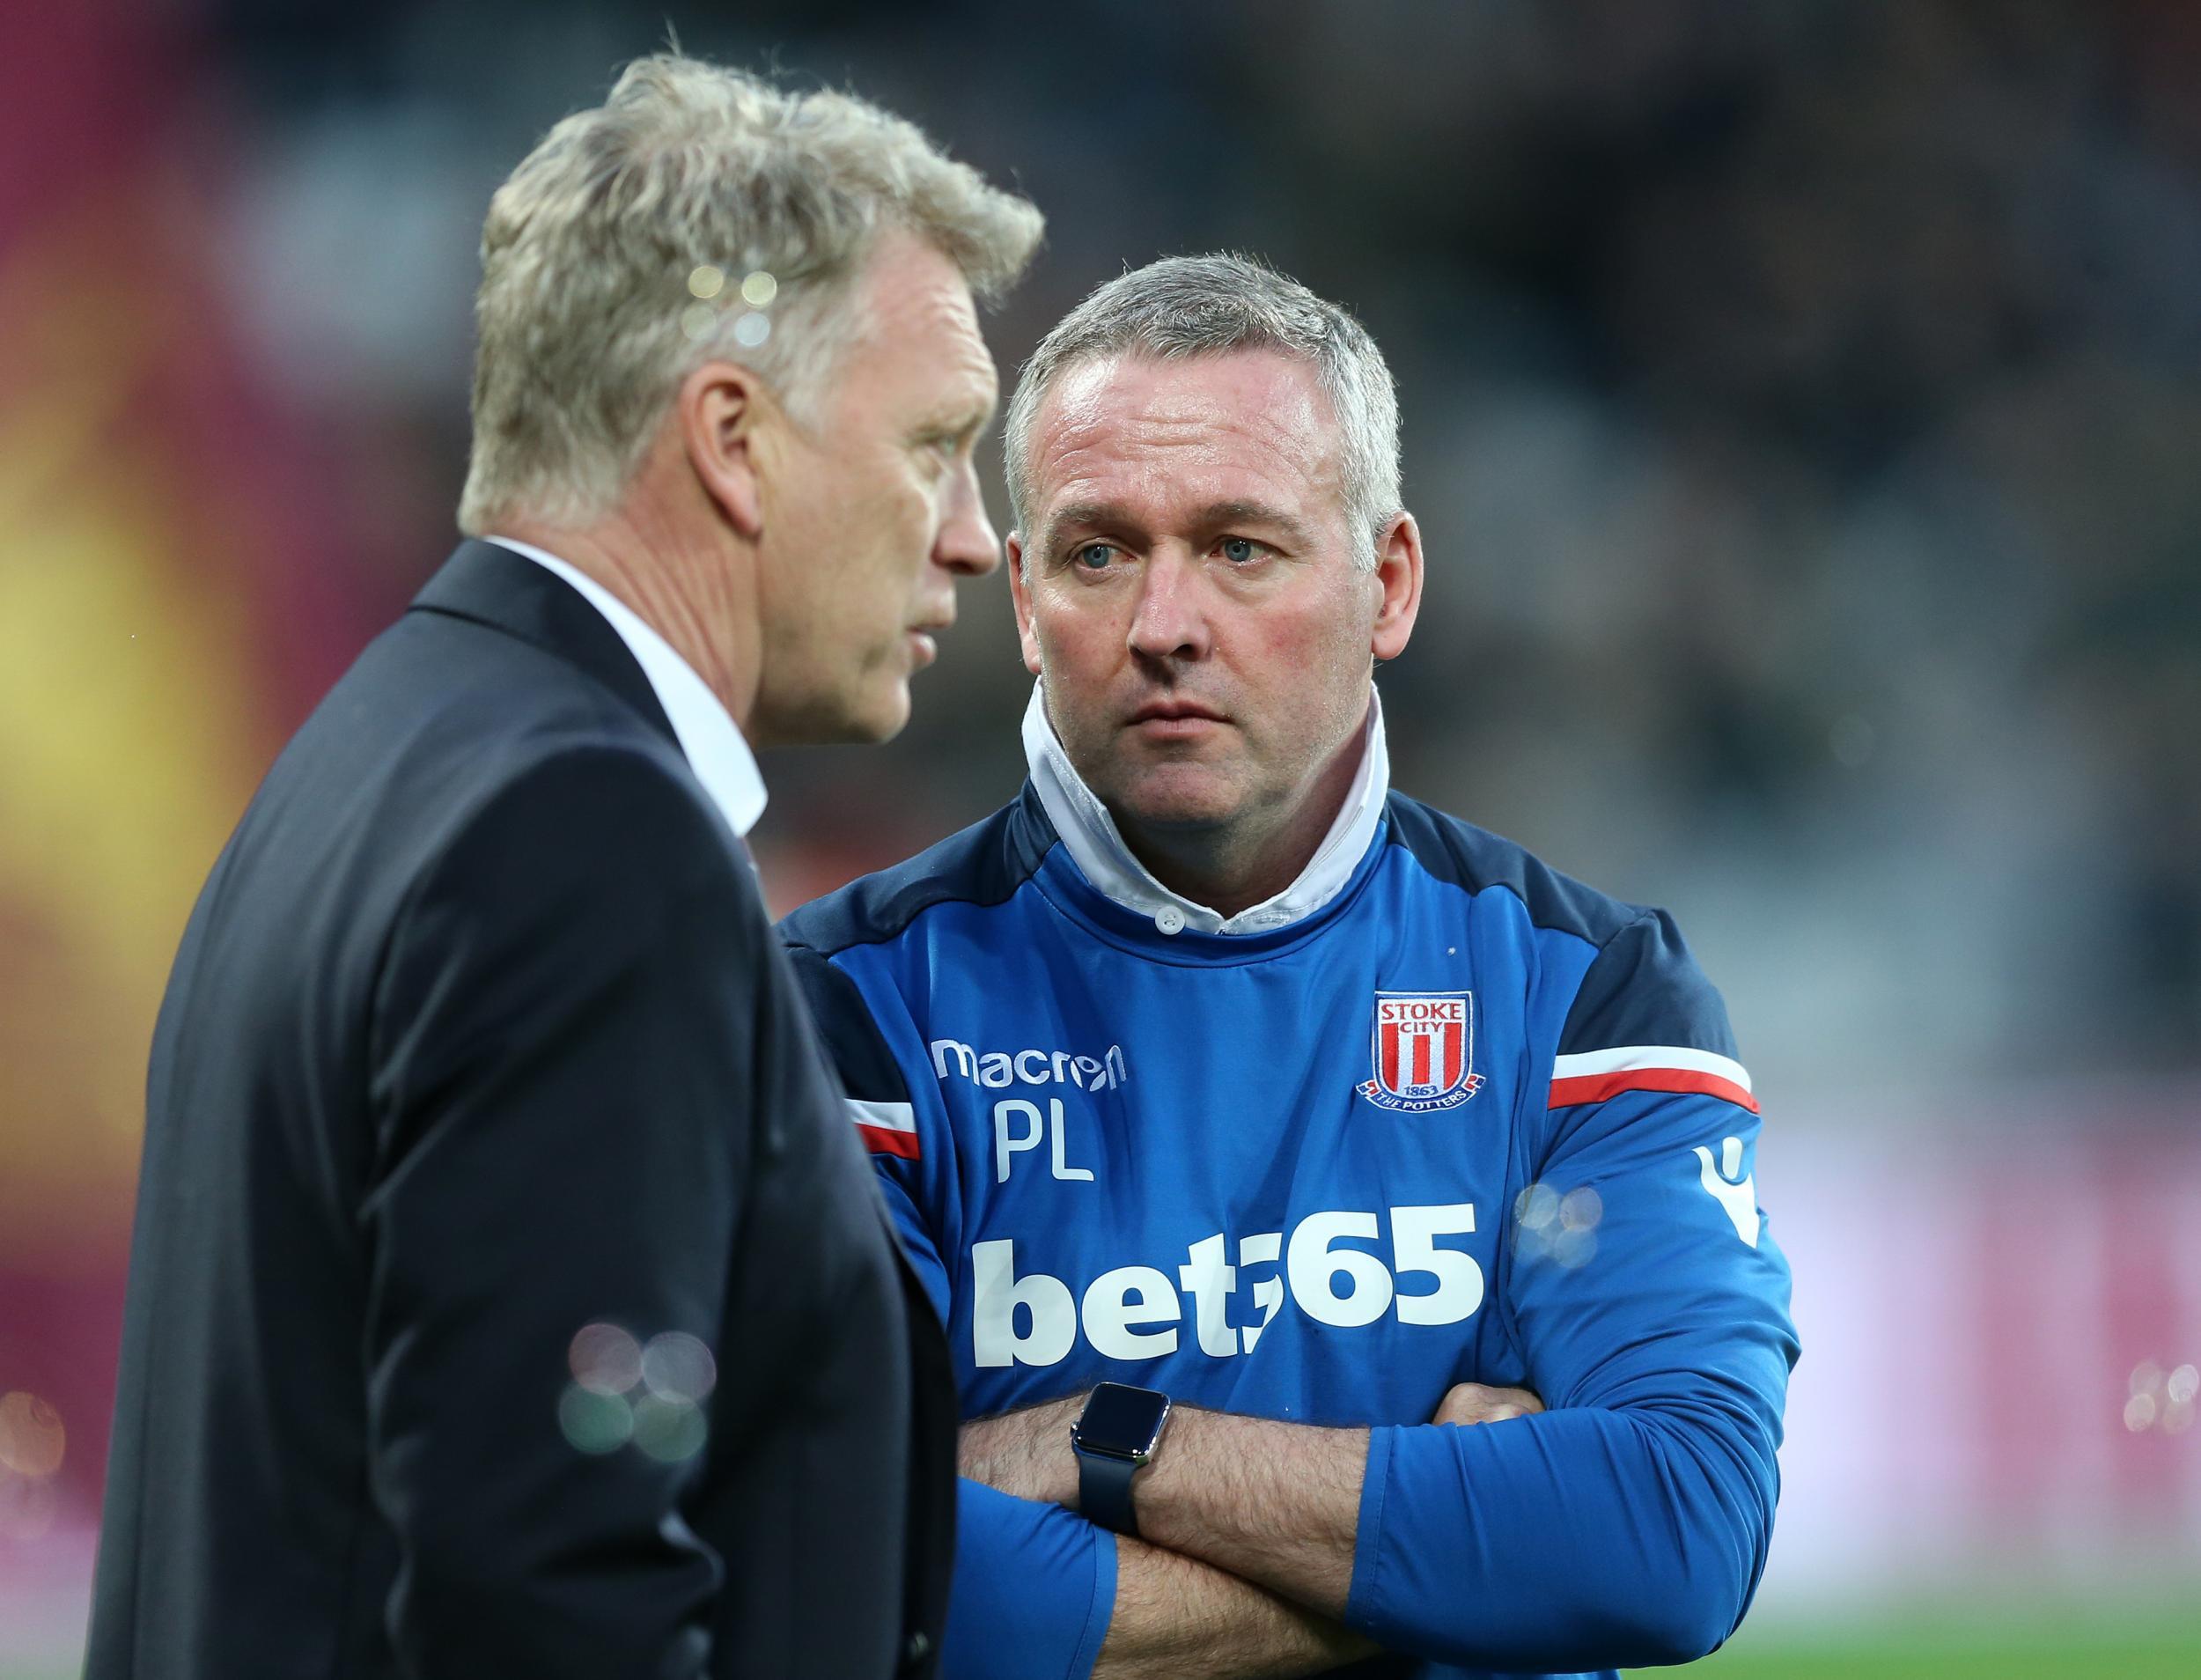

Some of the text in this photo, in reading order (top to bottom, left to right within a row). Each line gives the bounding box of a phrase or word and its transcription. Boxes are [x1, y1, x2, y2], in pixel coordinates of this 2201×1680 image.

[1380, 1003, 1462, 1020] STOKE
[1400, 1021, 1443, 1033] CITY
[931, 1039, 1127, 1092] macron
[1379, 1090, 1467, 1110] THE POTTERS
[1403, 1086, 1439, 1096] 1863
[994, 1098, 1094, 1183] PL
[971, 1203, 1484, 1367] bet365
